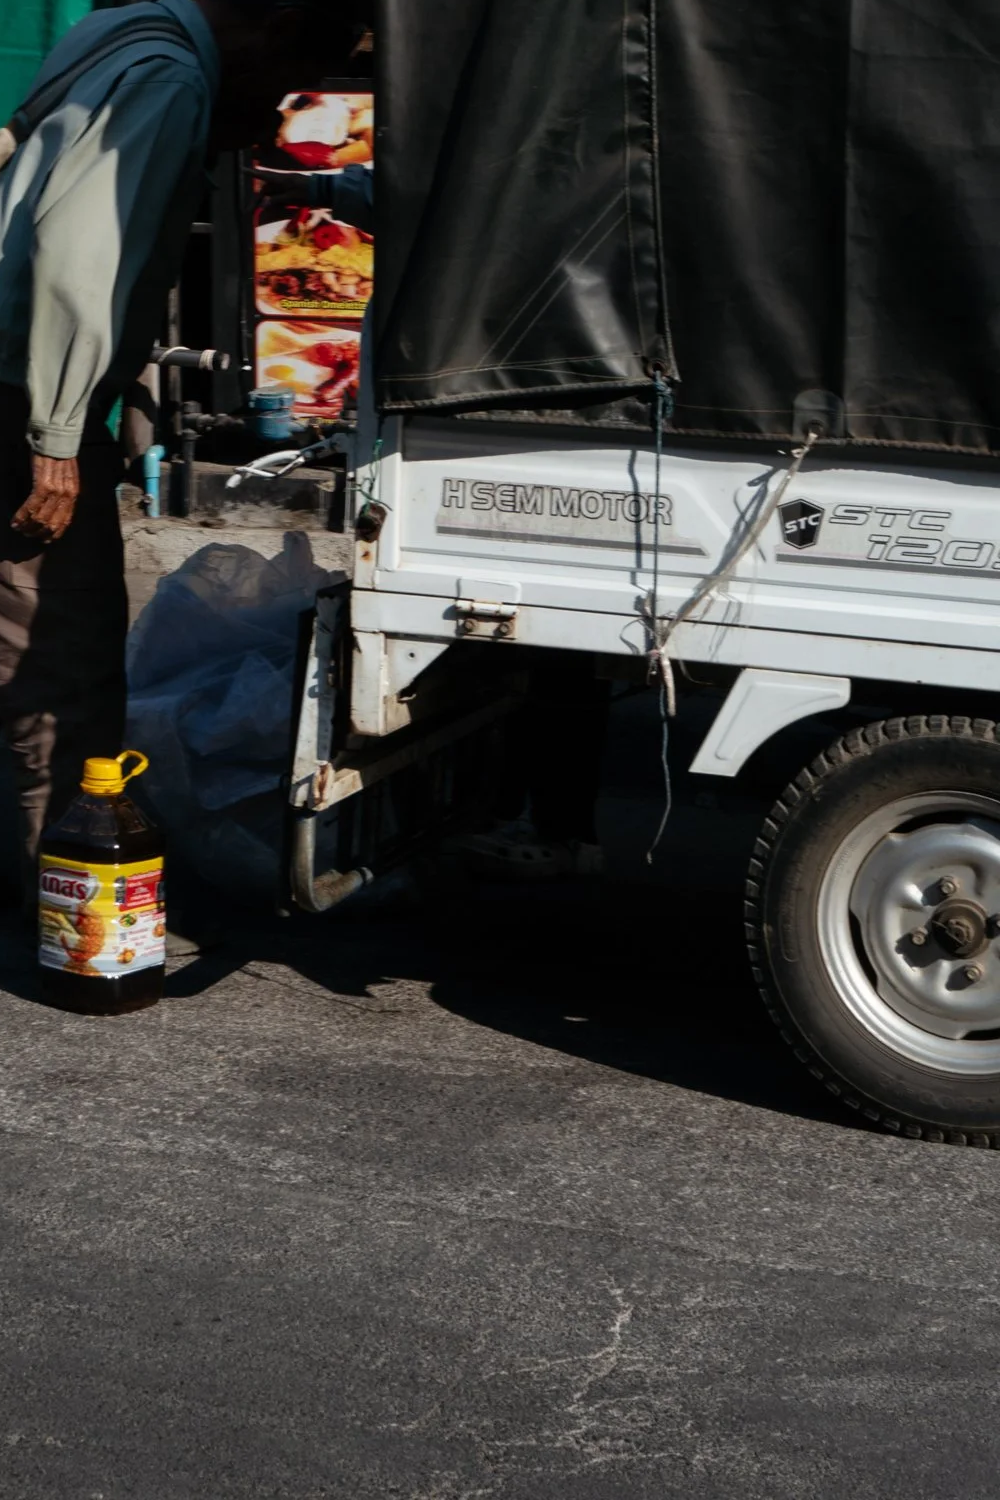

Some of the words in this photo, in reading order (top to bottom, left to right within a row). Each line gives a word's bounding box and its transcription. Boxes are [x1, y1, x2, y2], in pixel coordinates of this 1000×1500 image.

[442, 479, 465, 509] H
[471, 482, 544, 516] SEM
[550, 487, 674, 526] MOTOR
[784, 512, 822, 535] STC
[828, 504, 953, 532] STC
